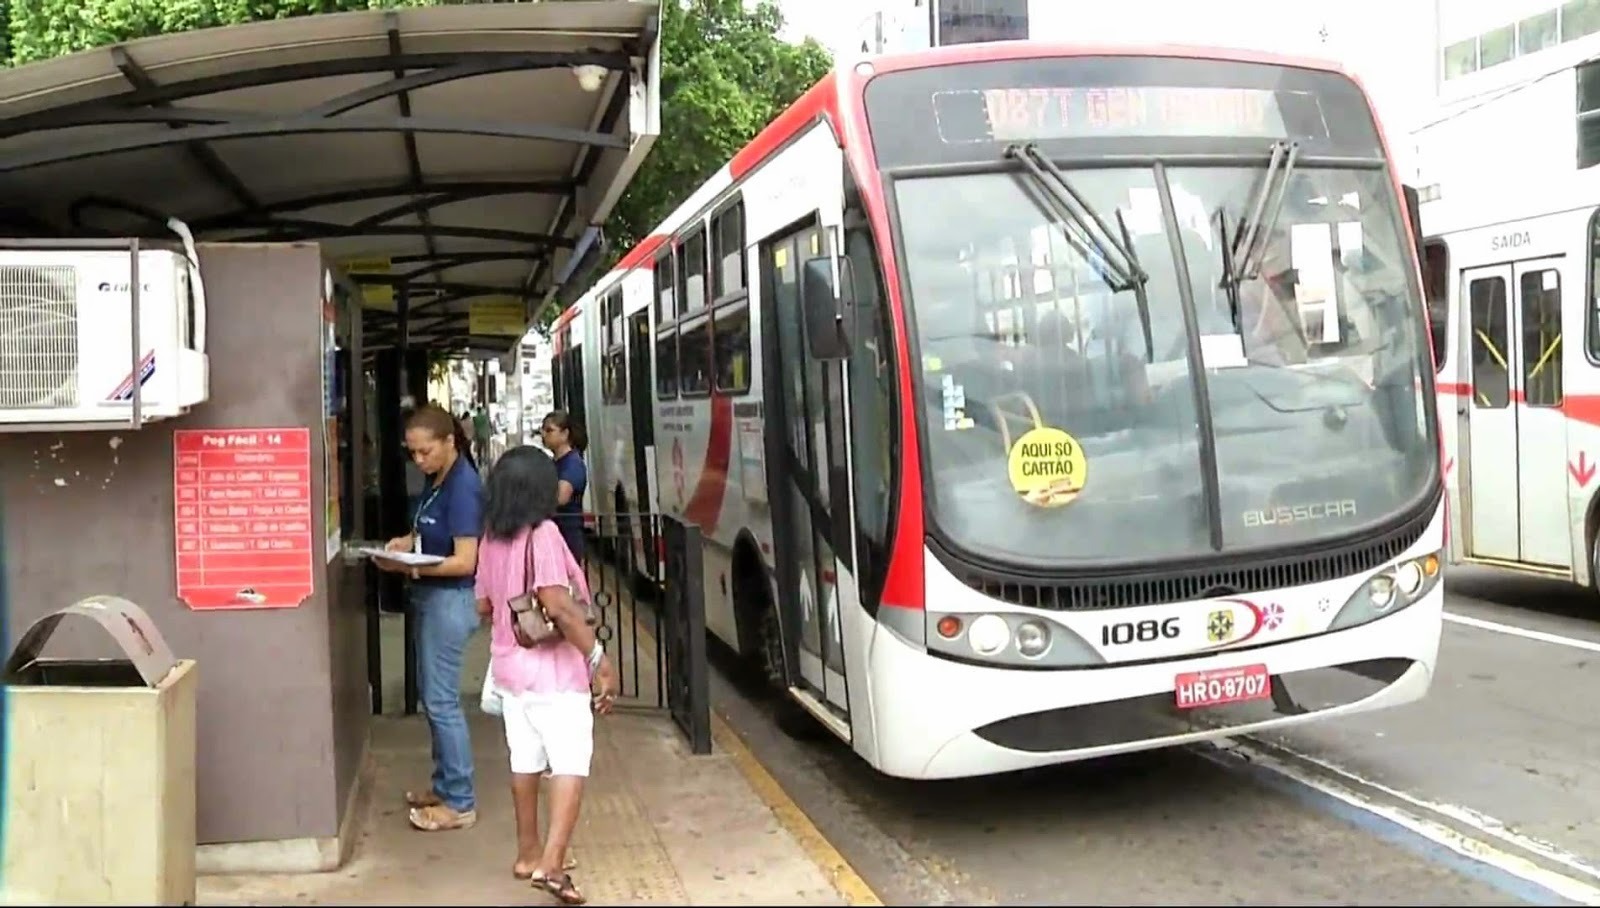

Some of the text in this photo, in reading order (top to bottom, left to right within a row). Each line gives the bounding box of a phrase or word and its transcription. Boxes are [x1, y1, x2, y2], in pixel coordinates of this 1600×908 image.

[266, 434, 281, 445] 14
[1021, 439, 1073, 458] AQUI SÓ
[1022, 457, 1074, 476] CARTÃO
[1242, 499, 1357, 528] BUSSCAR
[1101, 616, 1181, 647] 1086
